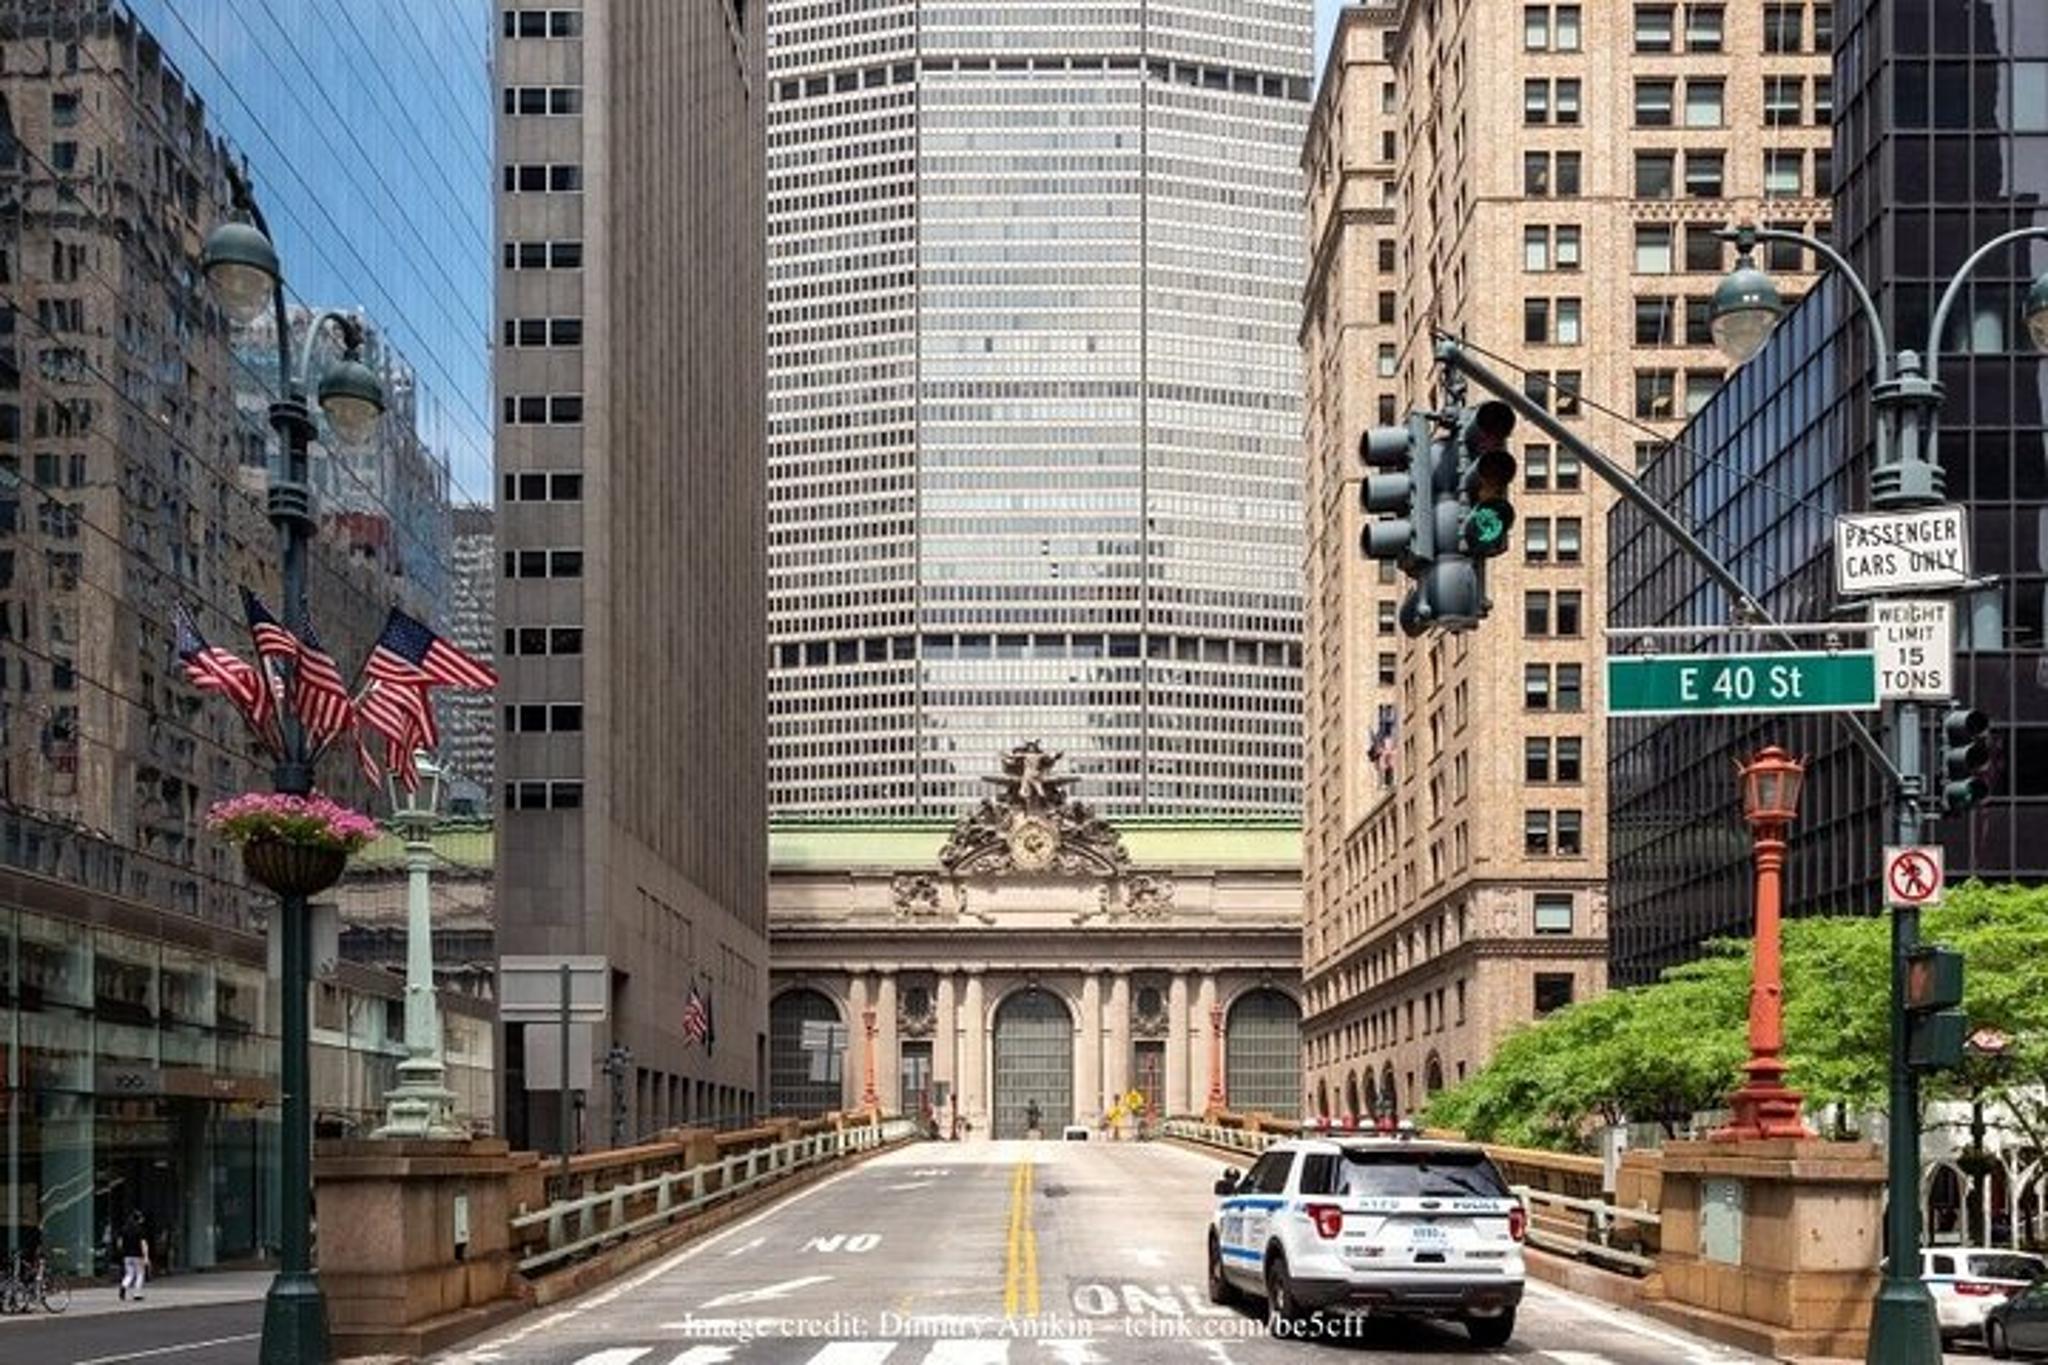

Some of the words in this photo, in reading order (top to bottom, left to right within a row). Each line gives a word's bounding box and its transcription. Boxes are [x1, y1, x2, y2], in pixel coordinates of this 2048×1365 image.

[1846, 518, 1957, 549] PASSENGER
[1846, 553, 1898, 579] CARS
[1909, 547, 1958, 573] ONLY
[1878, 605, 1945, 623] WEIGHT
[1888, 626, 1934, 643] LIMIT
[1899, 647, 1925, 667] 15
[1681, 667, 1699, 701] E
[1711, 665, 1756, 701] 40
[1769, 664, 1803, 699] St
[1882, 670, 1941, 690] TONS
[799, 1233, 883, 1252] NO
[1072, 1284, 1244, 1317] ONL
